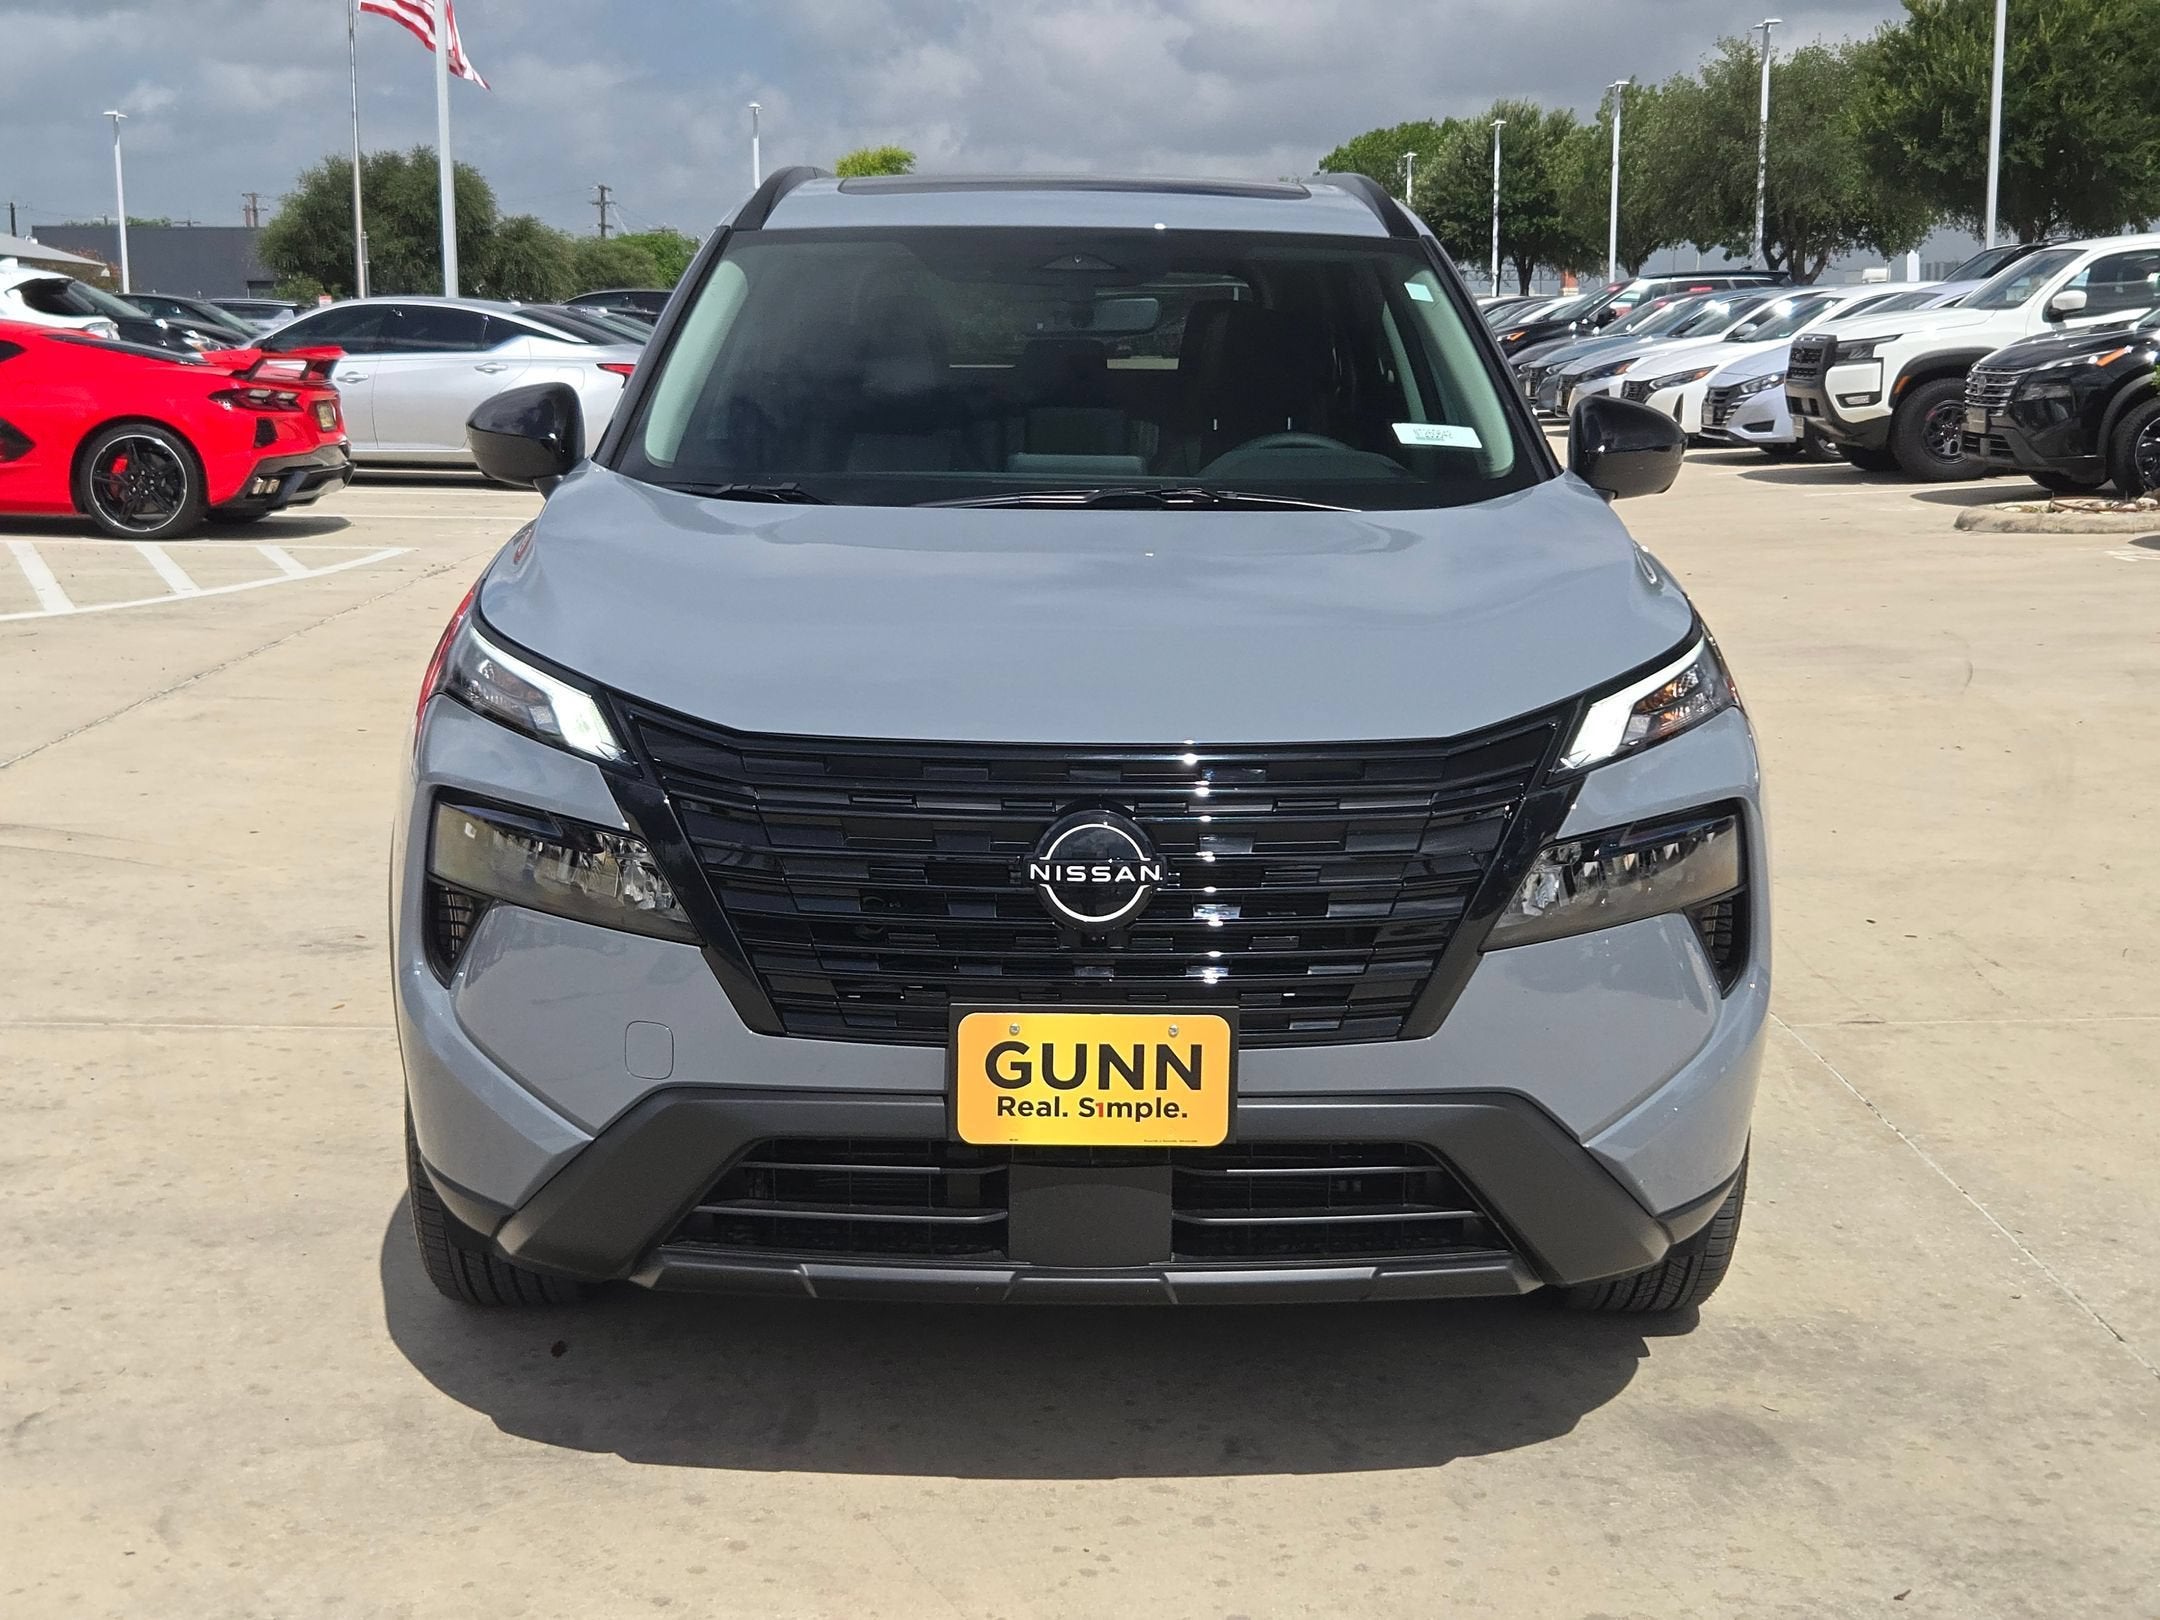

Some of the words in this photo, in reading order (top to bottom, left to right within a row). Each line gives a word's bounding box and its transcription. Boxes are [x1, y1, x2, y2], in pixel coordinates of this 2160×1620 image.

[1029, 863, 1161, 882] NISSAN
[984, 1040, 1202, 1091] GUNN
[997, 1095, 1068, 1117] Real.
[1078, 1096, 1188, 1122] S1mple.
